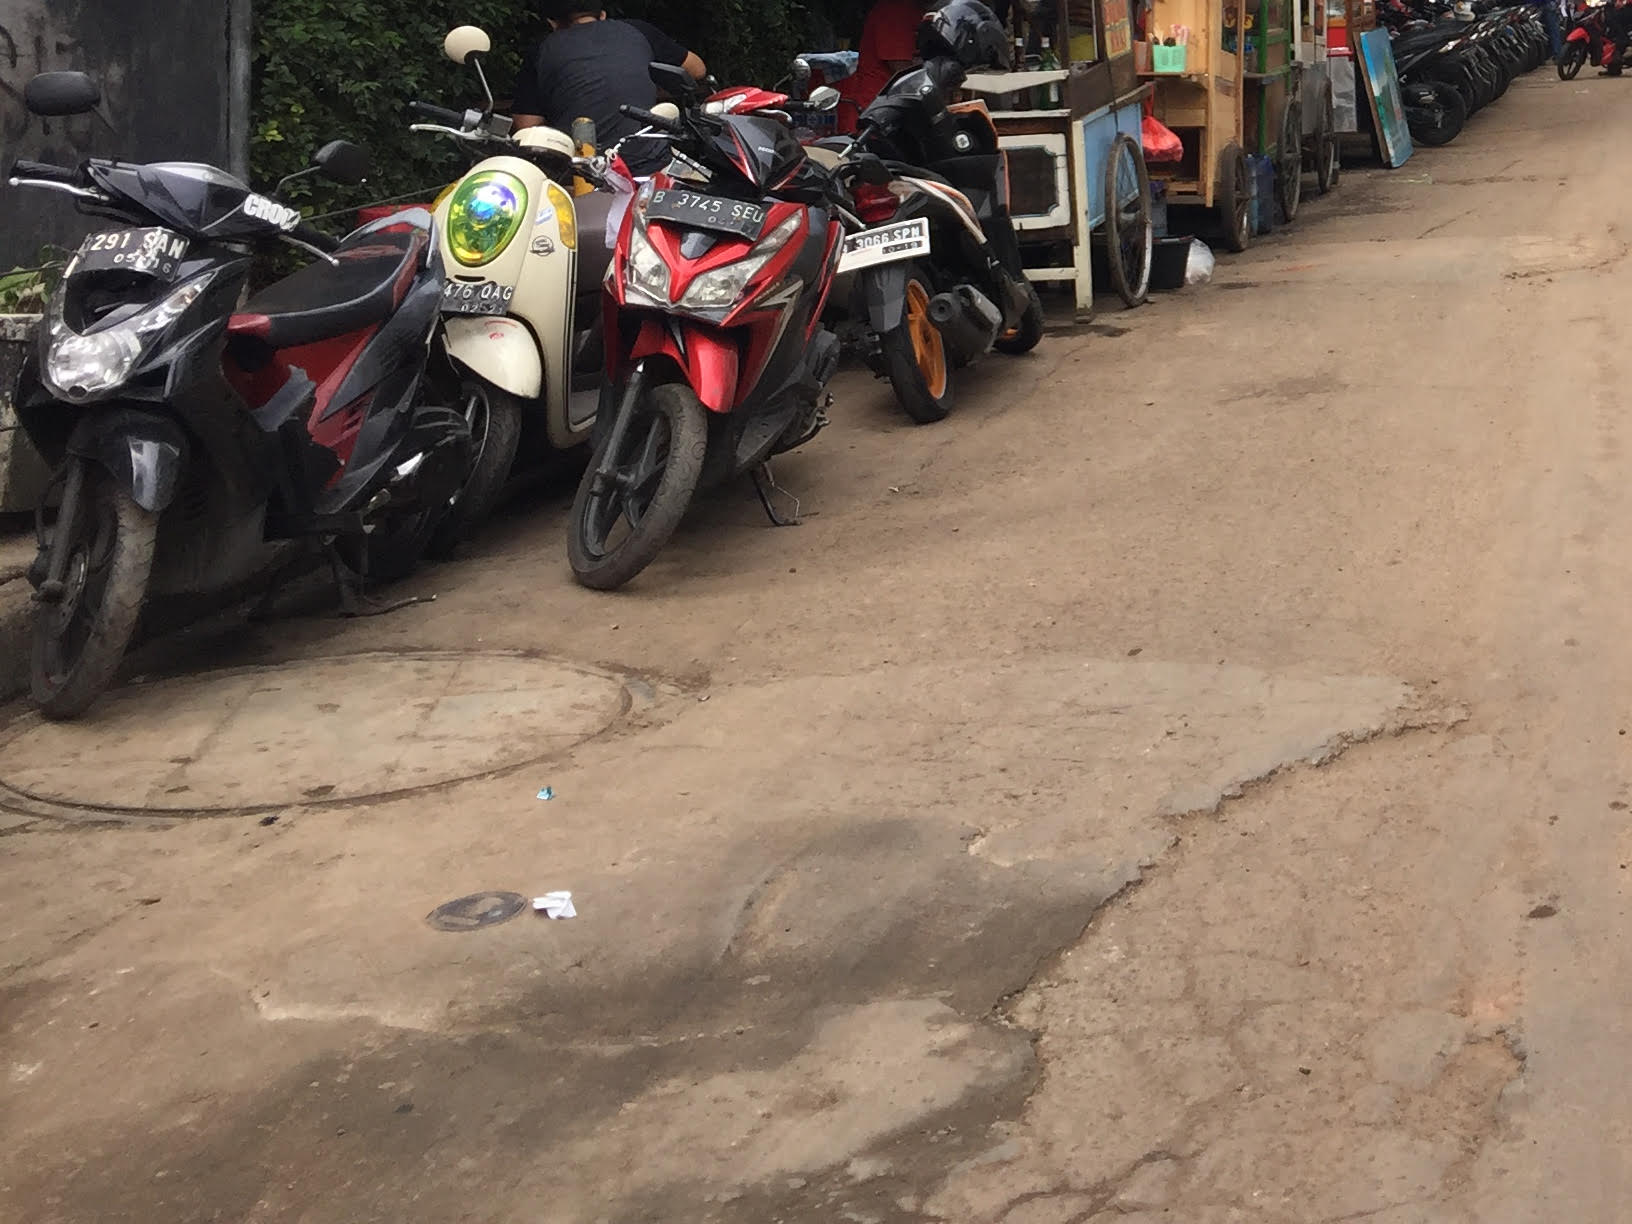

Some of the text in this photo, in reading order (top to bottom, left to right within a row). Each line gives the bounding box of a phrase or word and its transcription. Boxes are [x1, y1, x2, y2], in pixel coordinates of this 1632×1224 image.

[653, 191, 764, 223] B 3745 SEU
[855, 232, 889, 251] 3066
[480, 283, 513, 301] QAG
